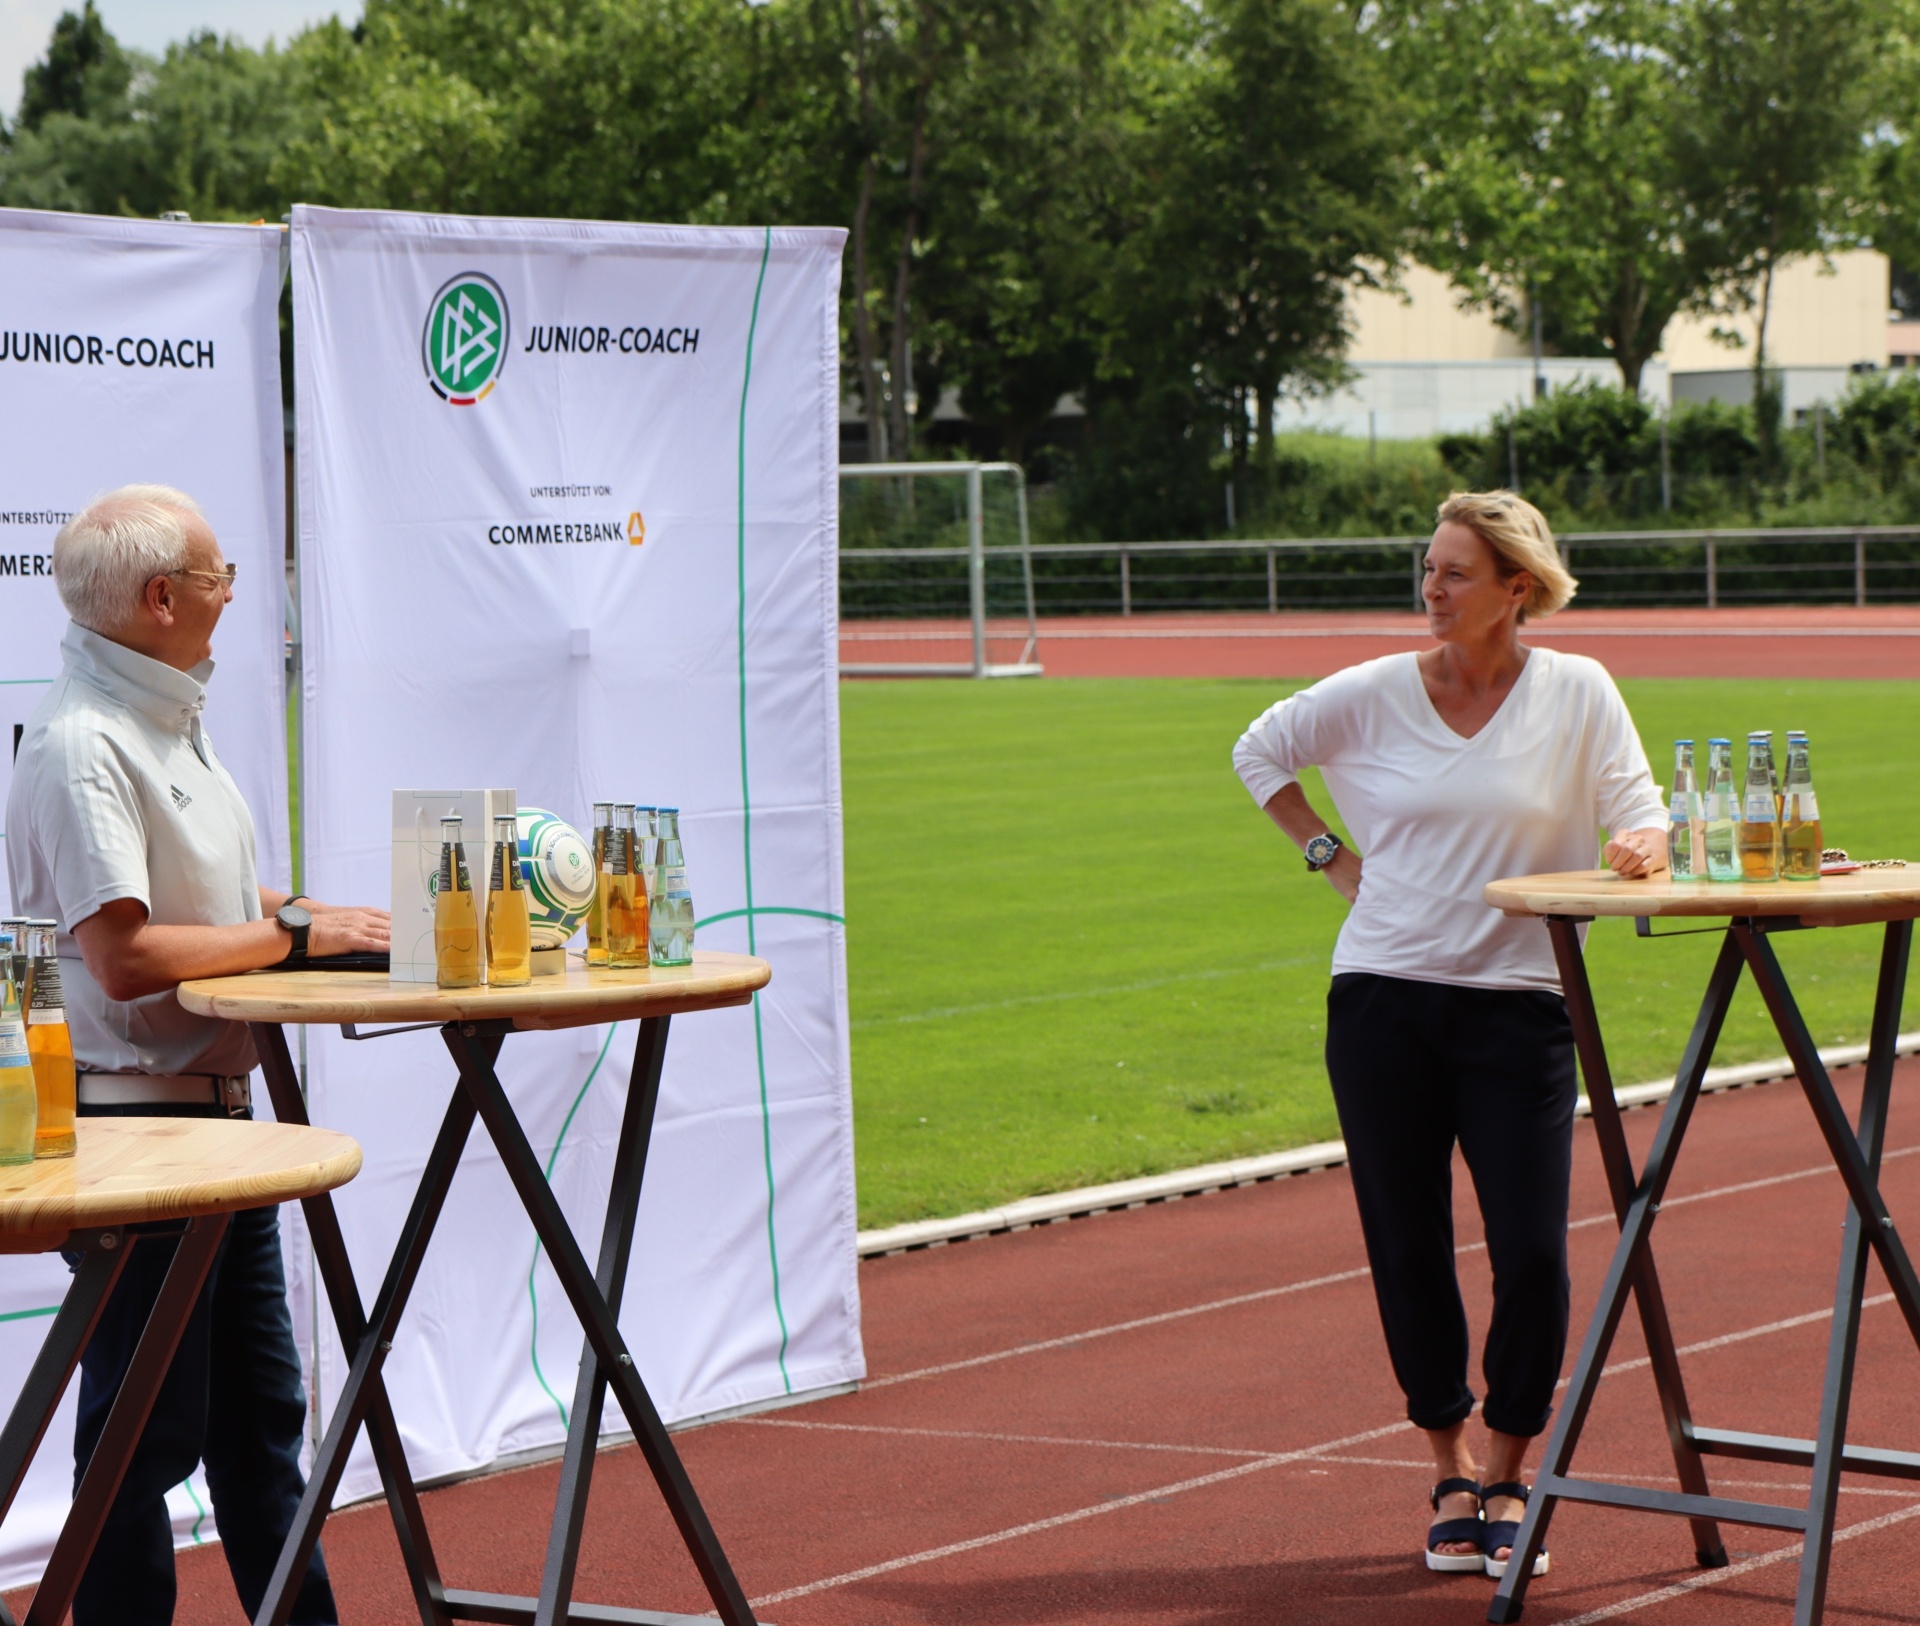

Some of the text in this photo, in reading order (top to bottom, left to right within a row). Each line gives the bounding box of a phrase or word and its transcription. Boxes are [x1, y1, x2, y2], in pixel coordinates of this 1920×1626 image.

[0, 331, 215, 369] JUNIOR-COACH
[524, 326, 700, 354] JUNIOR-COACH
[530, 485, 613, 498] UNTERSTÜTZT VON:
[488, 522, 624, 545] COMMERZBANK
